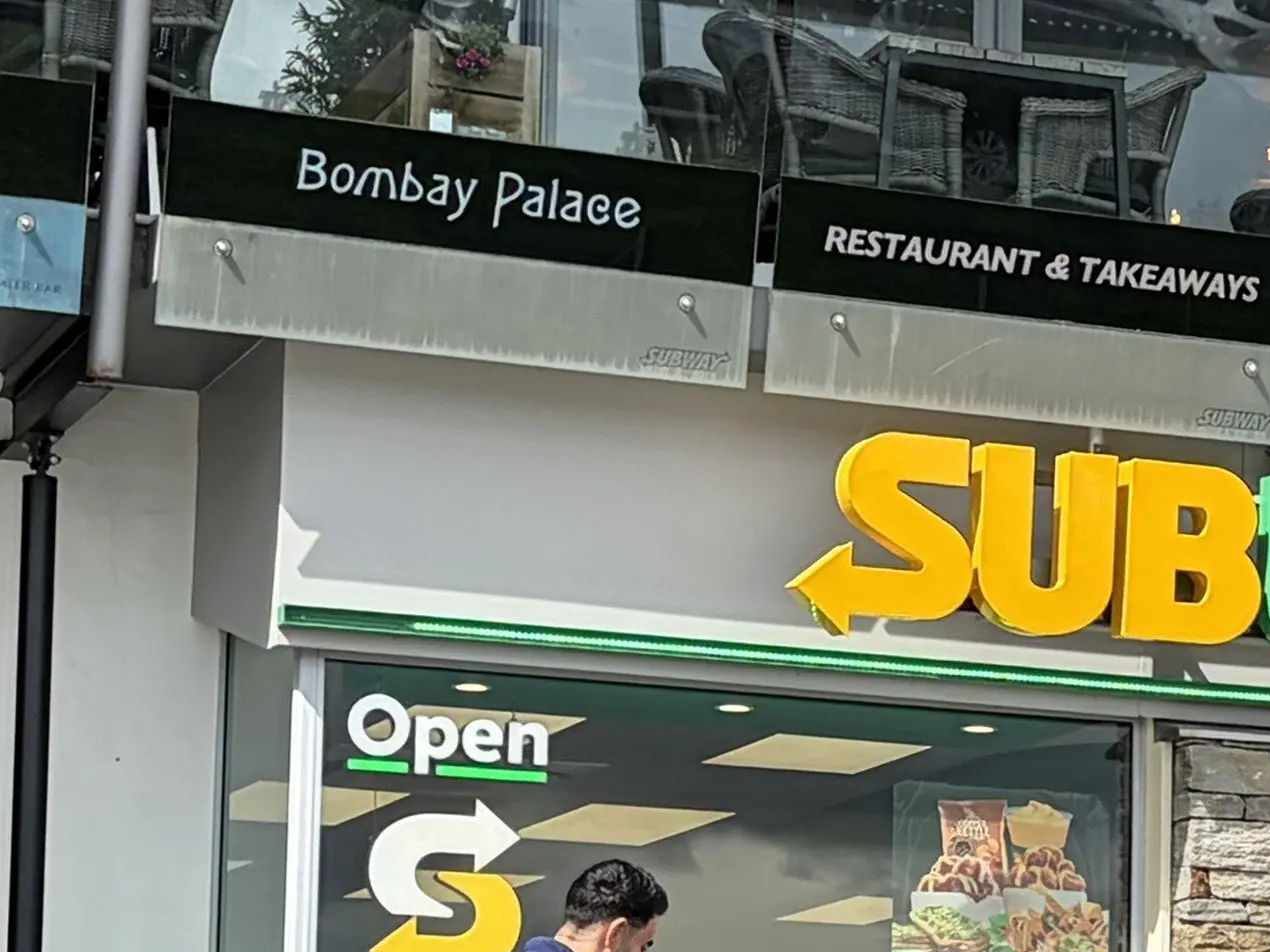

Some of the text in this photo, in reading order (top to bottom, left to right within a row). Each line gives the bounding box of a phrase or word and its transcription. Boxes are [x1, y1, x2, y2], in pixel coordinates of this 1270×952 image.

[297, 147, 642, 229] Bombay Palace
[824, 225, 1260, 302] RESTAURANT & TAKEAWAYS
[639, 346, 732, 372] SUBWAY
[347, 693, 549, 775] Open
